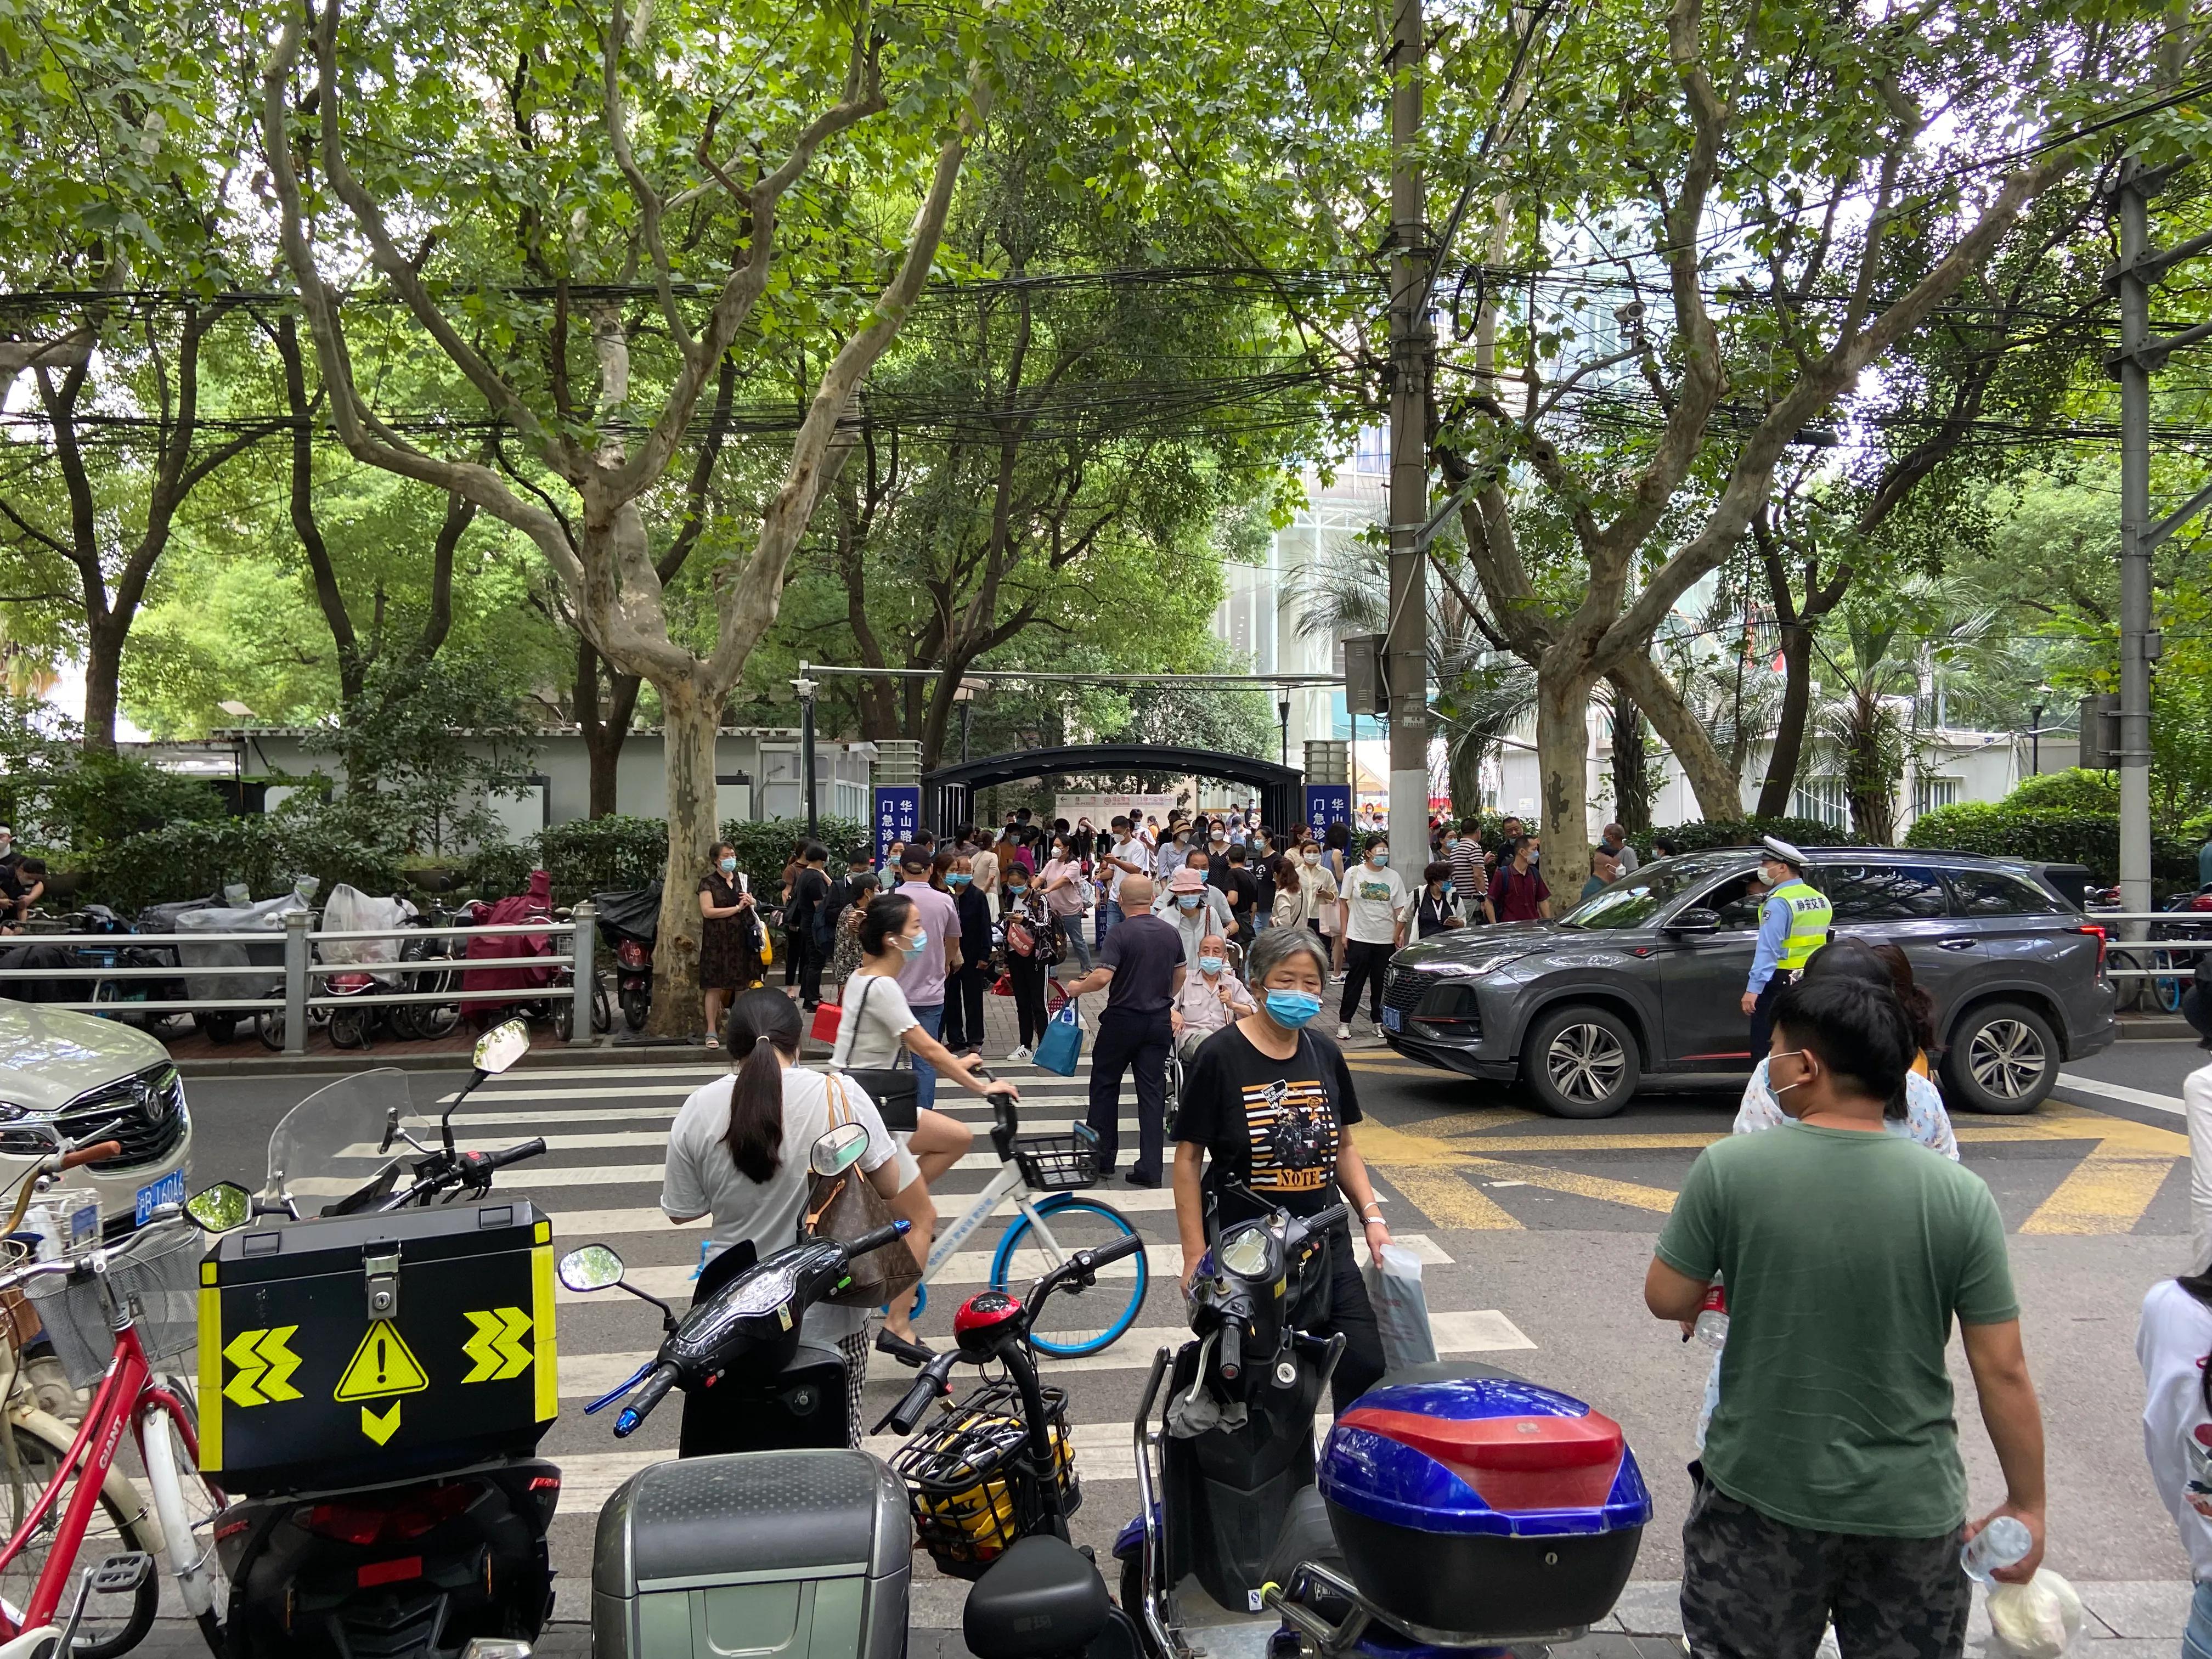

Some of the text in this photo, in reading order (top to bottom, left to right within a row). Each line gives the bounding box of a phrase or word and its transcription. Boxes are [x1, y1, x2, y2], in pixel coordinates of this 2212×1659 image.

[900, 800, 912, 843] 华山路
[1281, 1171, 1317, 1187] NOTE
[99, 1414, 122, 1470] GIANT
